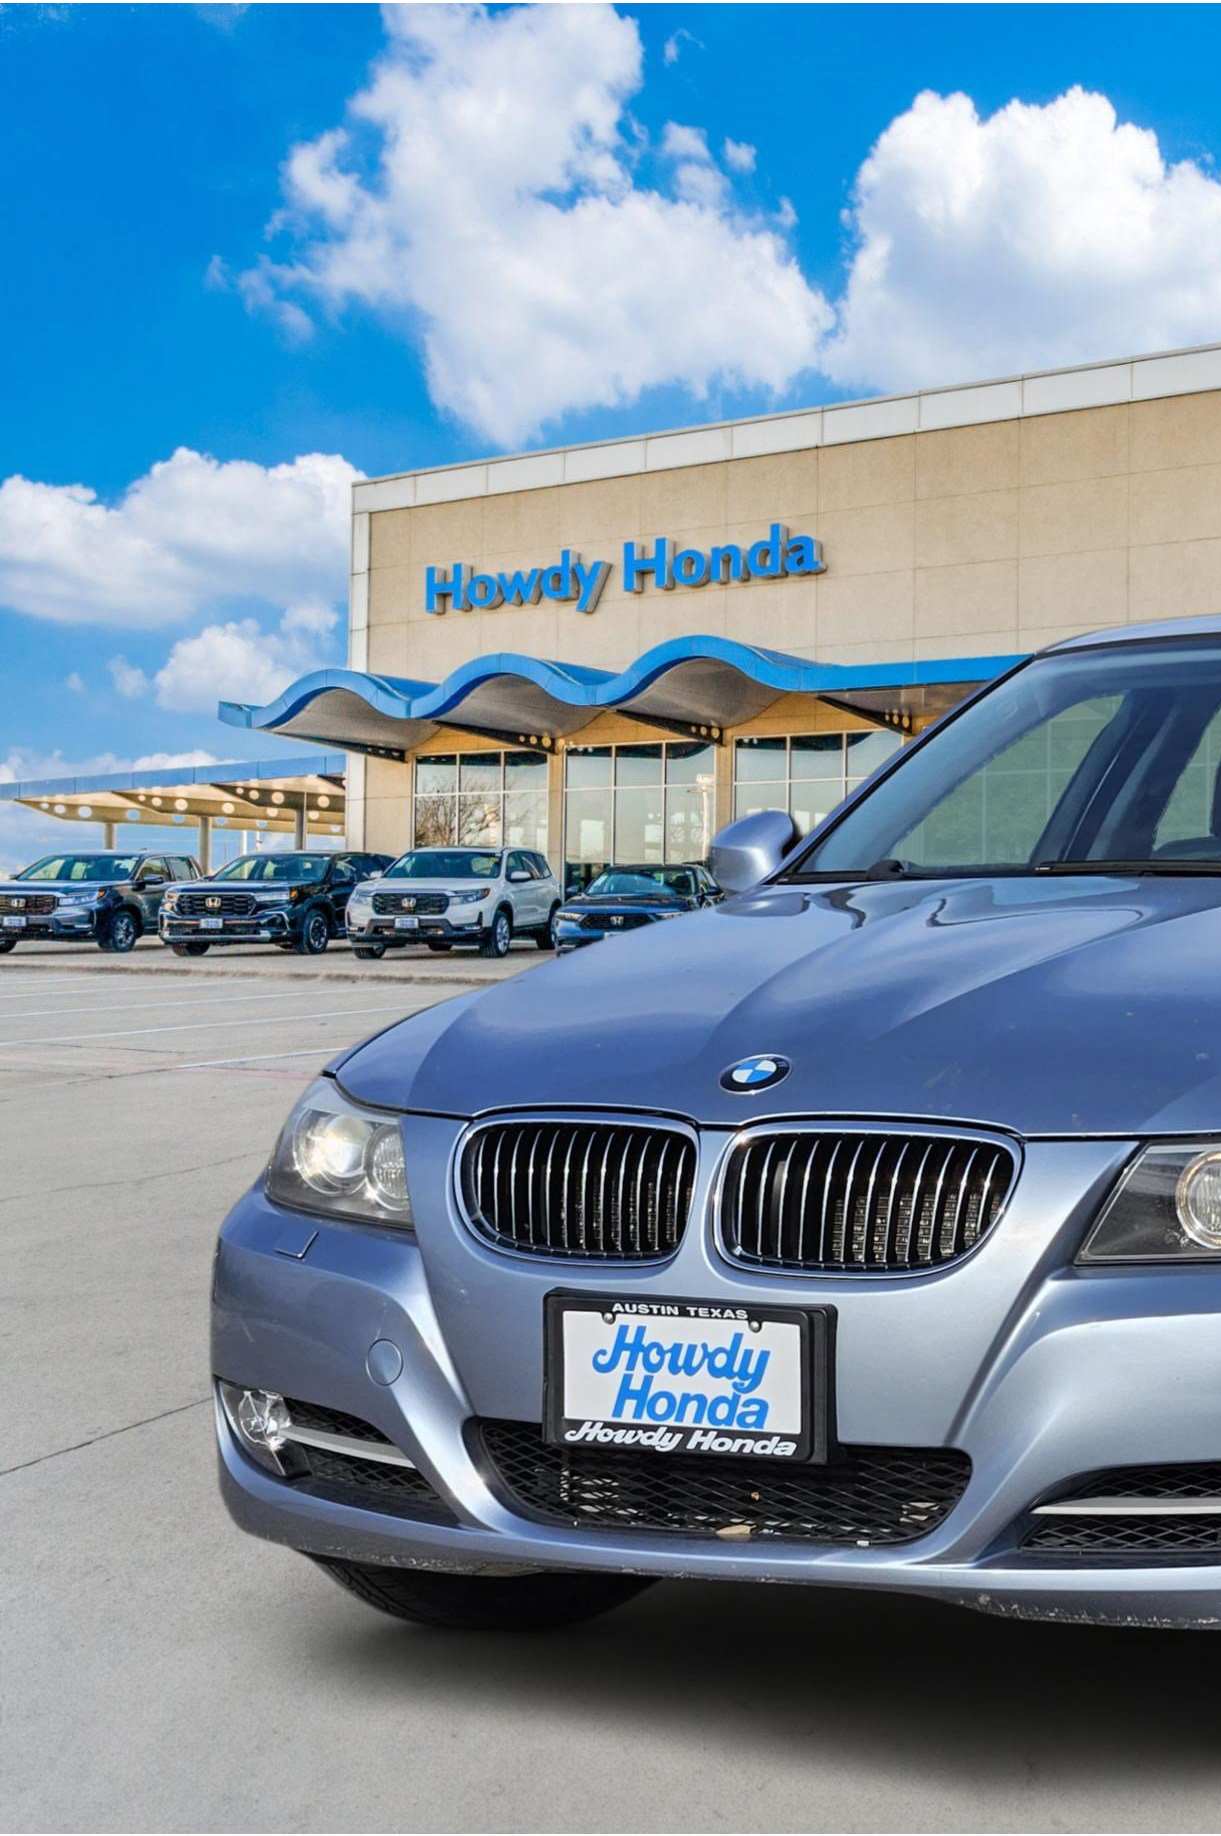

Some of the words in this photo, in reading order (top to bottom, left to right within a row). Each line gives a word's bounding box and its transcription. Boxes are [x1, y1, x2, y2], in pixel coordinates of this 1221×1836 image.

[425, 548, 612, 615] Howdy
[623, 522, 828, 594] Honda
[612, 1303, 680, 1316] AUSTIN
[686, 1306, 749, 1320] TEXAS
[592, 1324, 771, 1394] Howdy
[611, 1373, 770, 1430] Honda
[564, 1421, 683, 1452] Howdy
[686, 1430, 797, 1457] Honda
